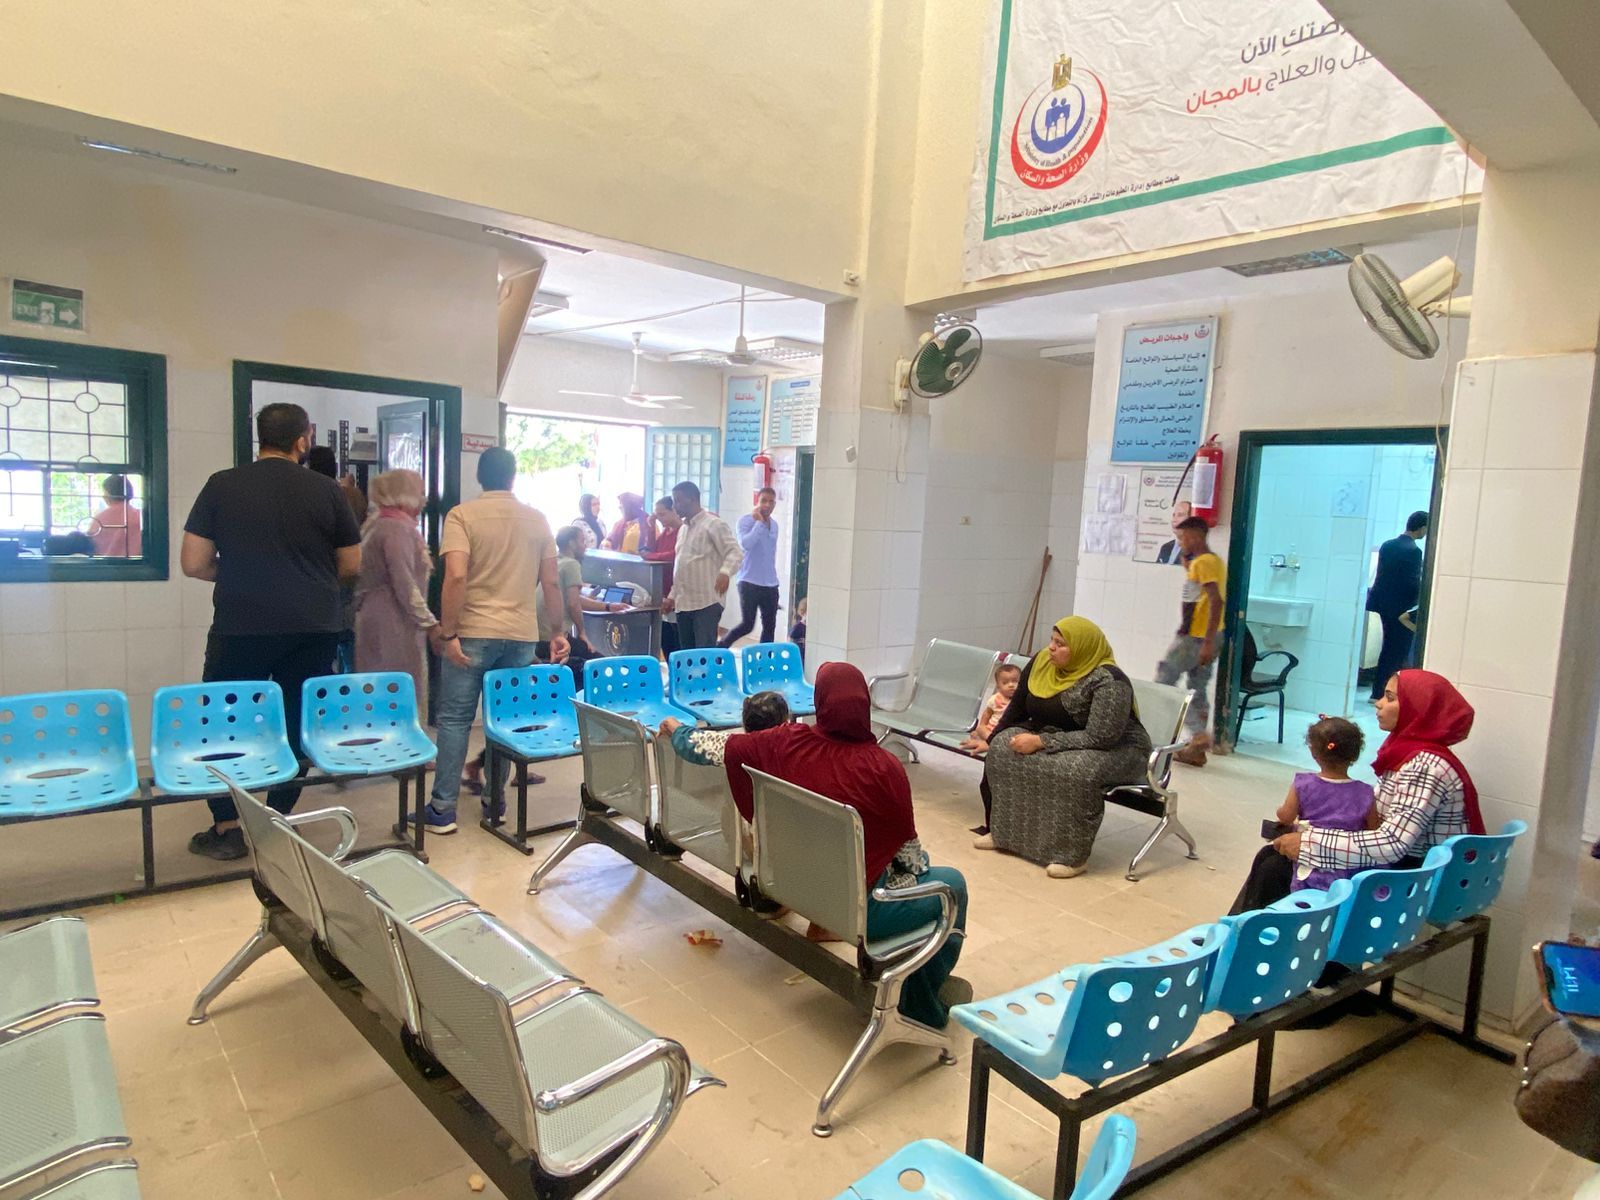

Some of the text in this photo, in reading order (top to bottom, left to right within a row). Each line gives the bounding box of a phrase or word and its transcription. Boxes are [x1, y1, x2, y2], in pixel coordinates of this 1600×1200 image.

[1240, 34, 1277, 64] الآن
[1265, 54, 1336, 91] والعلاج
[1186, 77, 1262, 114] بالمجان
[1020, 151, 1089, 186] وزارة الصحة والسكان
[1139, 332, 1189, 345] واجبات المريض
